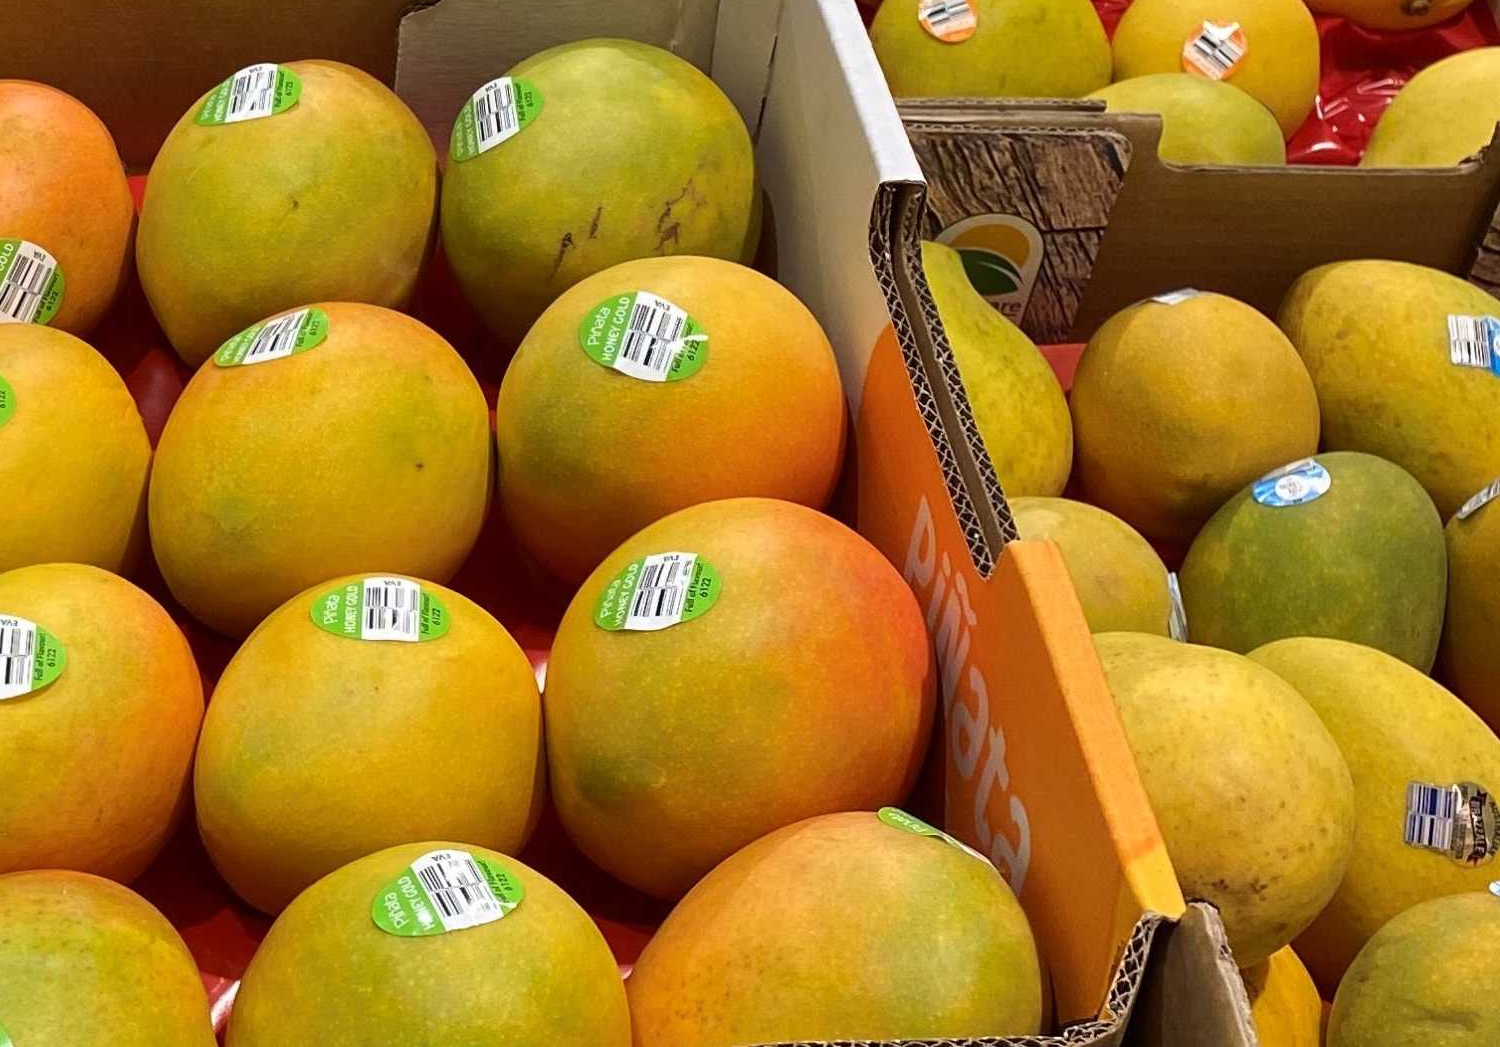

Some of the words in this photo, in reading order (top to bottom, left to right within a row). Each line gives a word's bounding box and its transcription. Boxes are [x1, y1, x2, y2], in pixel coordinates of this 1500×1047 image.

[602, 326, 623, 363] HONEY
[617, 296, 632, 325] GOLD
[687, 340, 701, 363] 6122
[346, 585, 359, 608] GOLD
[699, 577, 712, 598] 6122
[344, 607, 358, 633] HONEY
[432, 607, 441, 626] 6122
[47, 648, 57, 668] 6122
